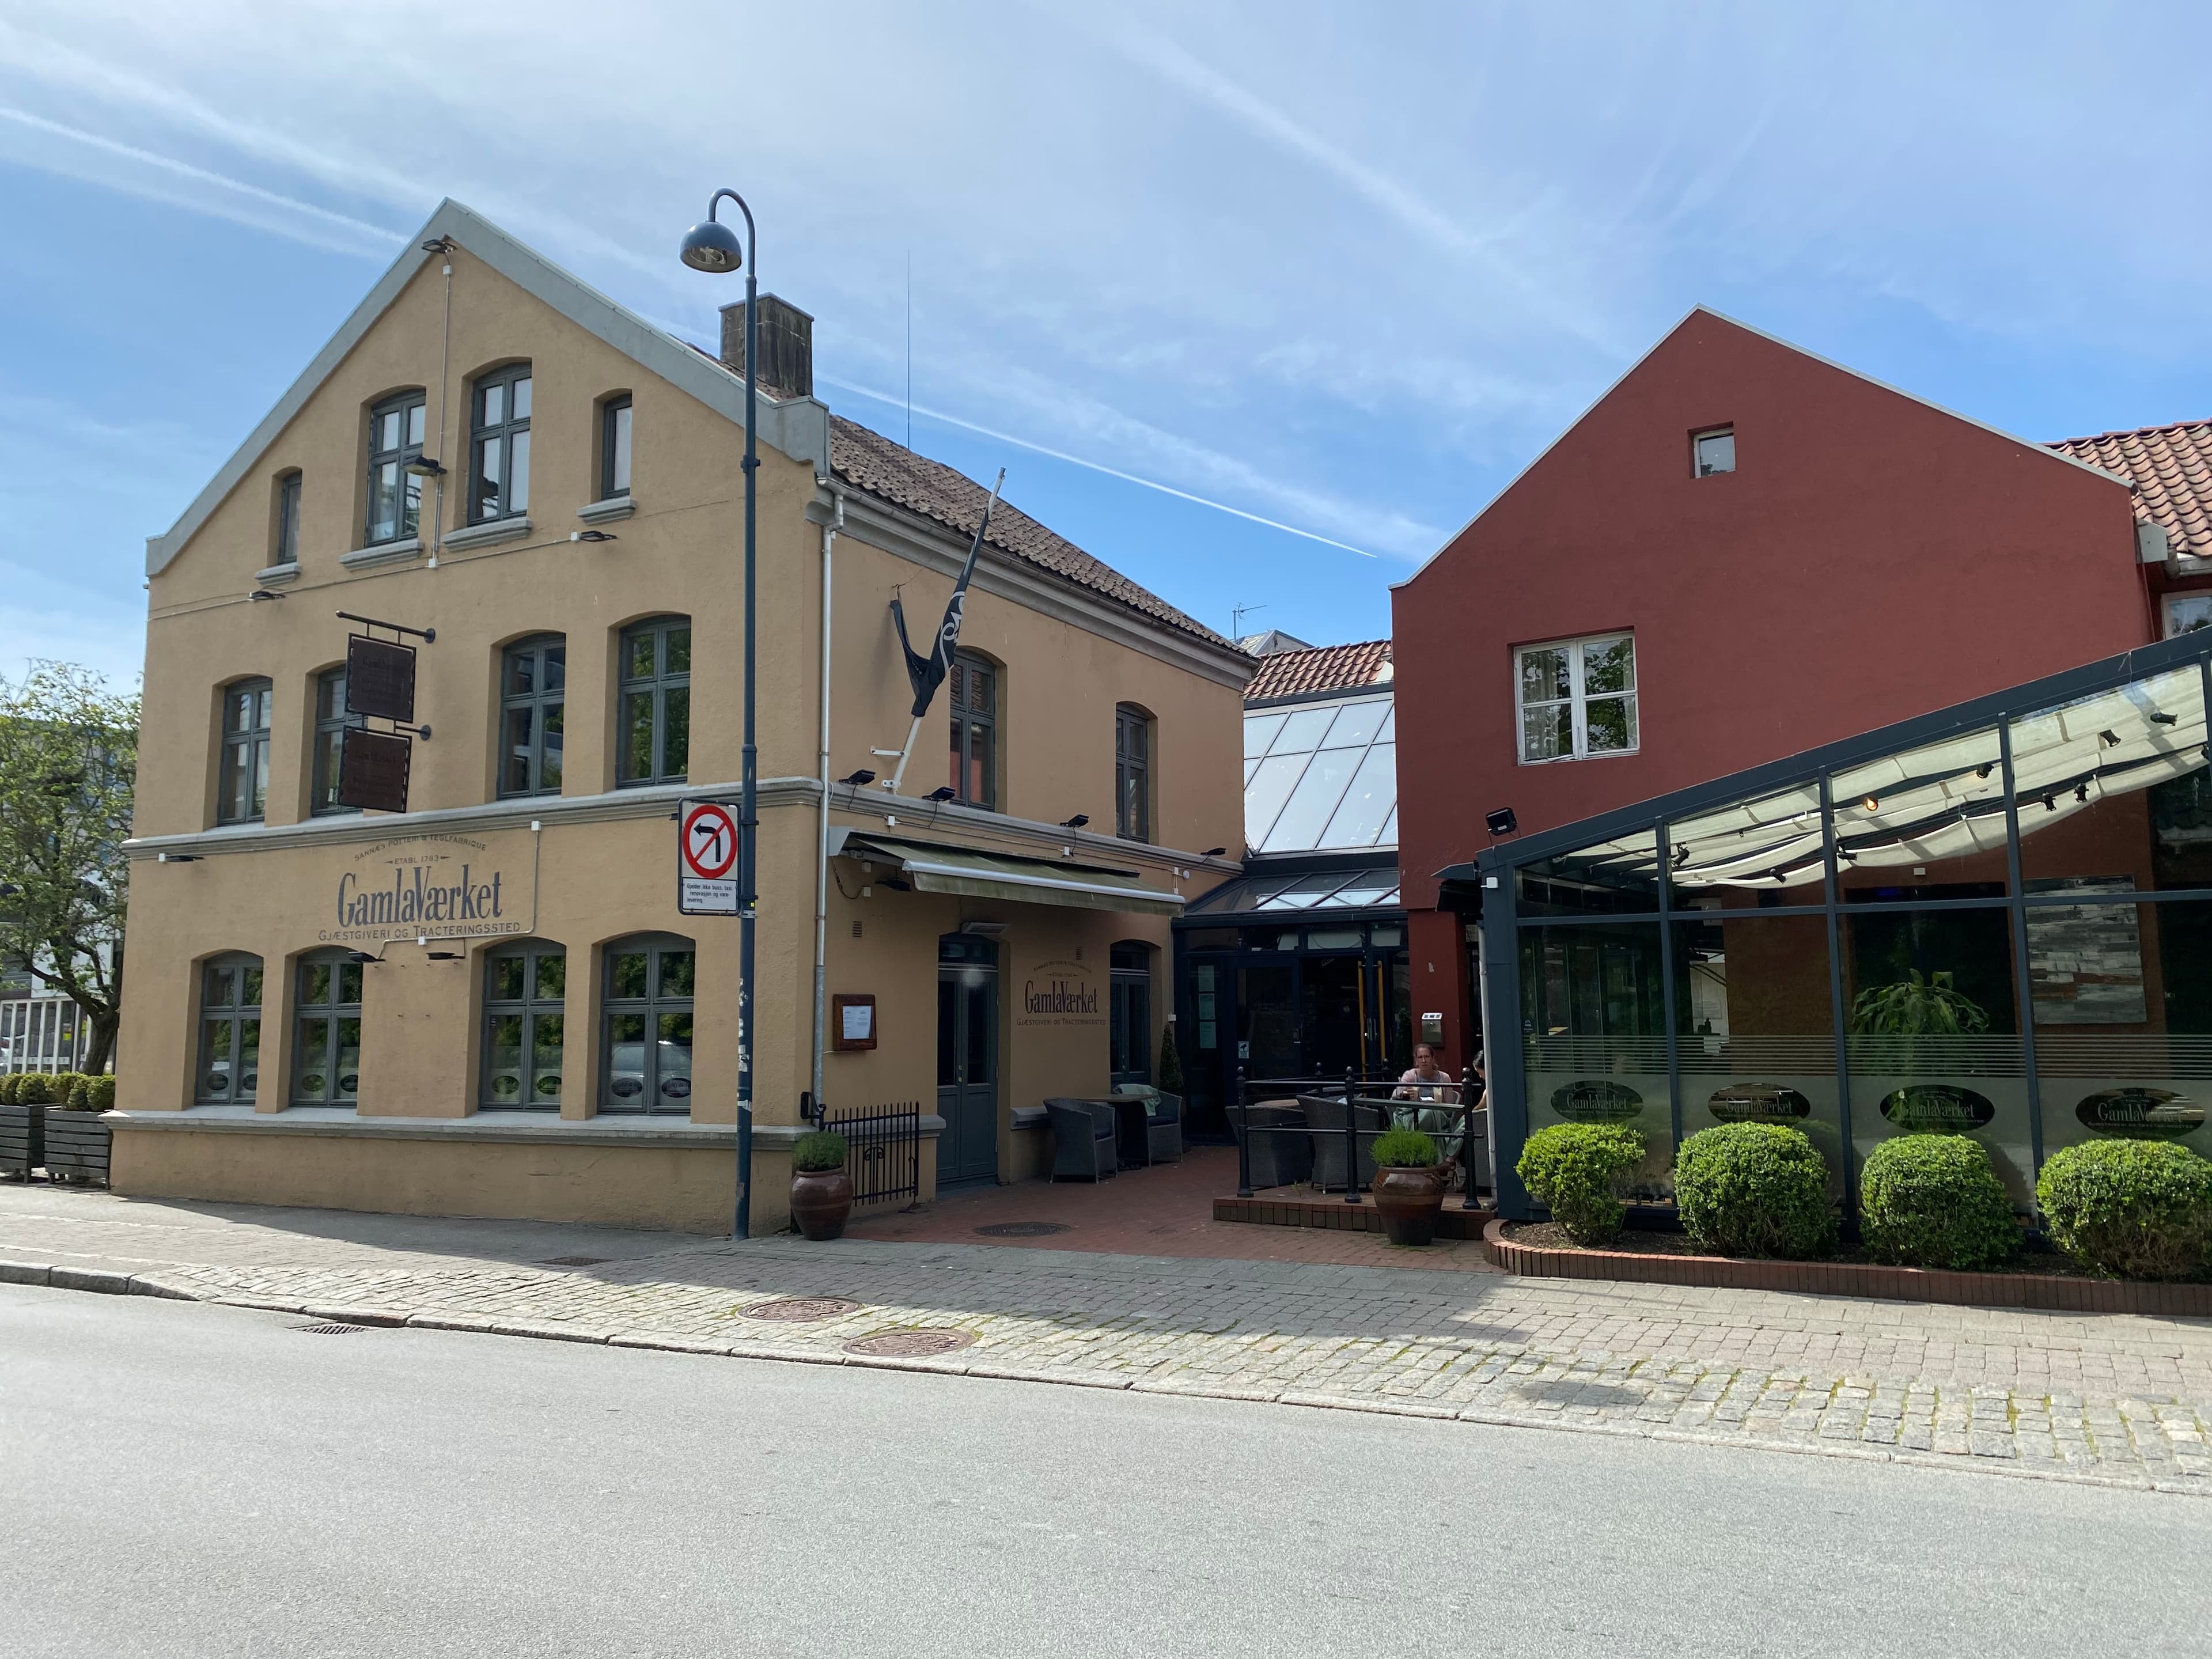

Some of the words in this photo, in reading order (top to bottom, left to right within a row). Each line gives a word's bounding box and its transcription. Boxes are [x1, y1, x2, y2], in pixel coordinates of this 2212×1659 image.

[430, 834, 487, 851] TEGLFABRIQUE
[338, 863, 503, 928] GamlaVærket
[413, 922, 520, 937] TRACTERINGSSTED
[1025, 980, 1098, 1014] GamlaVærket
